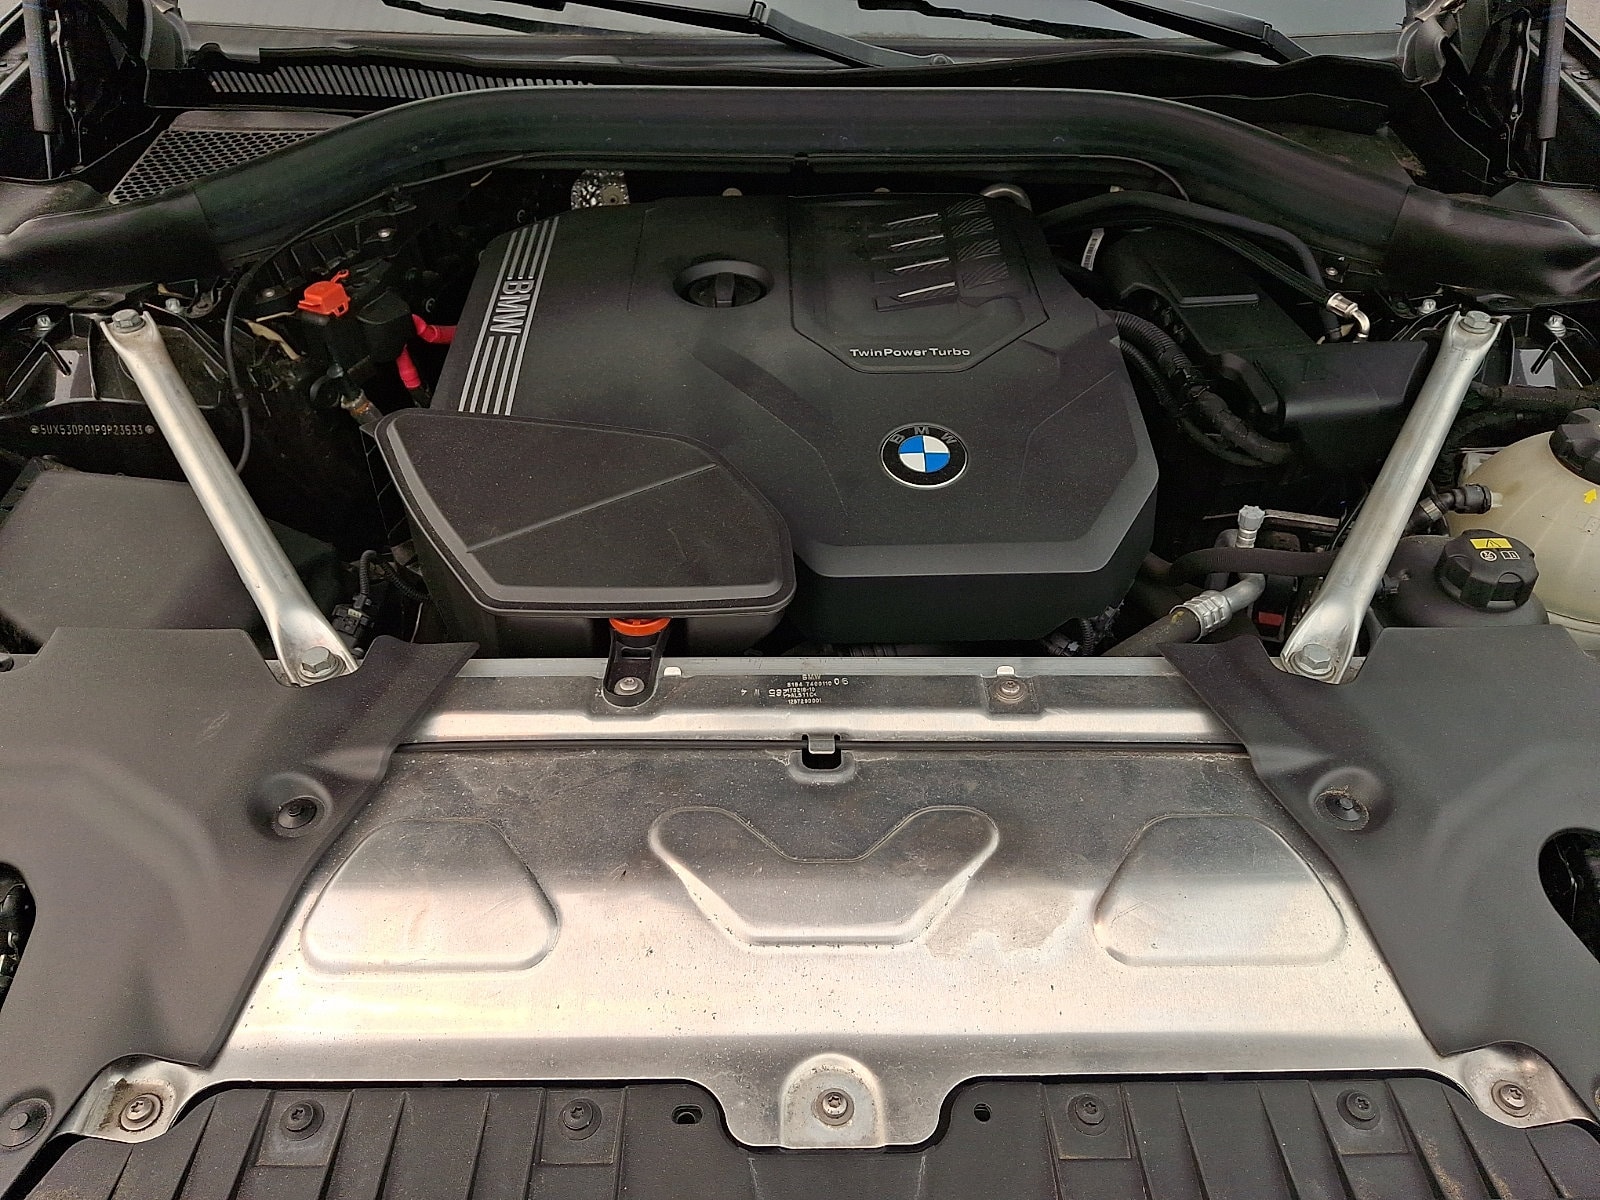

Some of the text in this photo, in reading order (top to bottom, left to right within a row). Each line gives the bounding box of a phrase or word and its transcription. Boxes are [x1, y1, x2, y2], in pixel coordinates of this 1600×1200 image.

[489, 279, 534, 334] BMW
[849, 347, 971, 357] TwinPower Turbo
[888, 425, 957, 444] BMW
[802, 673, 821, 681] BMW
